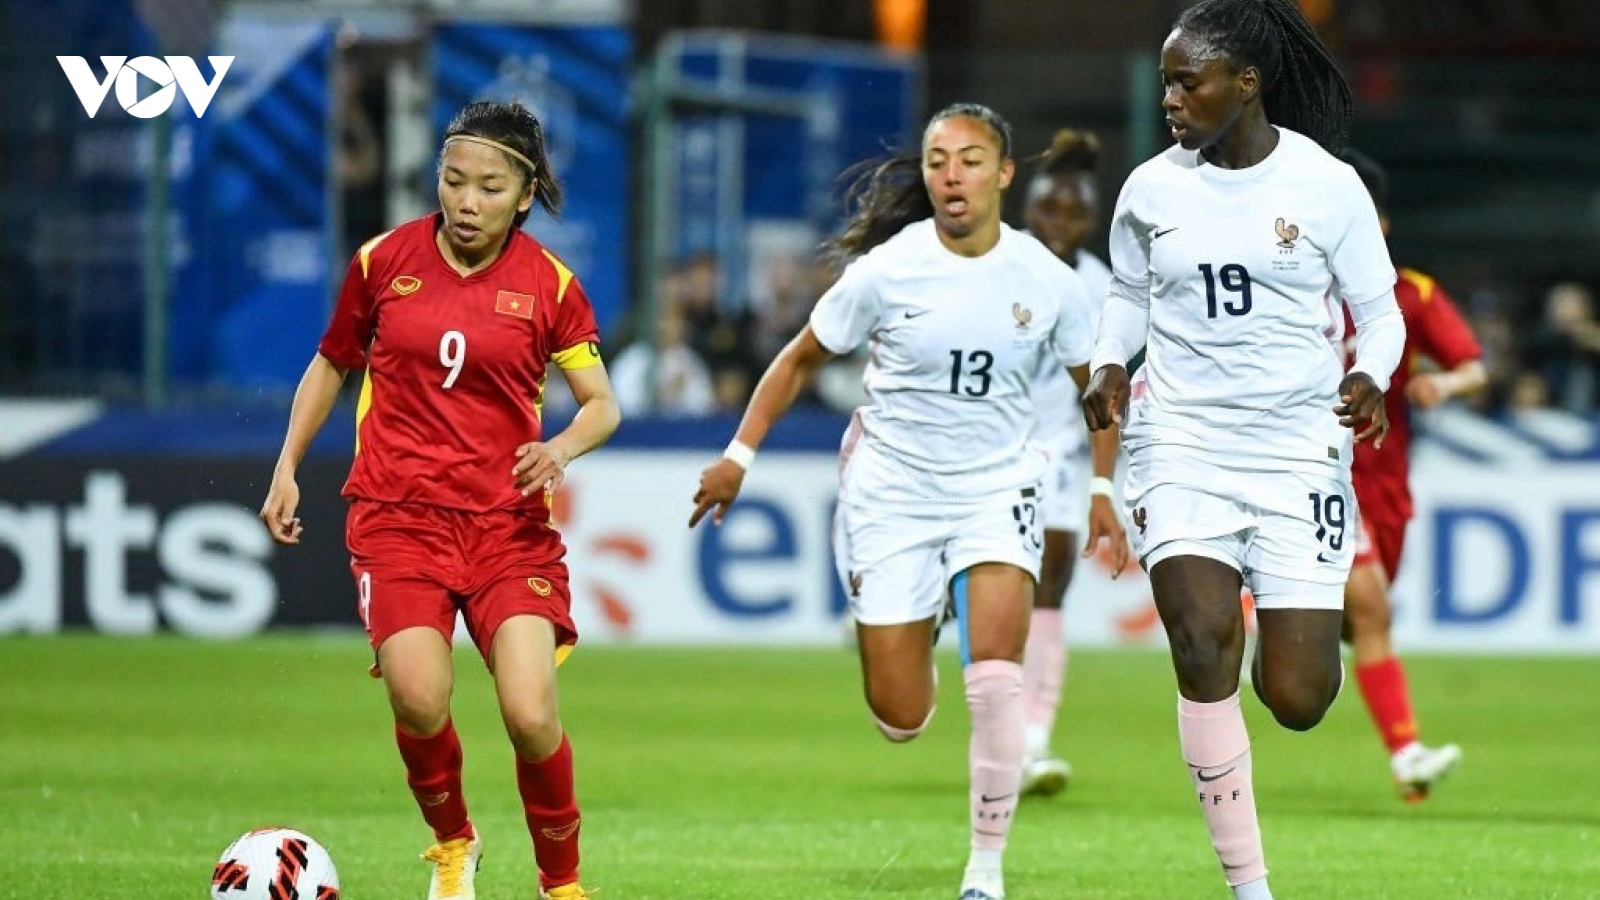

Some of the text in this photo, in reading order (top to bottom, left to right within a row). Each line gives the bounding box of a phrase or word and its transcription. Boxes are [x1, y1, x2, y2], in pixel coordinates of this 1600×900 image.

[1198, 263, 1252, 318] 19
[439, 330, 466, 389] 9
[949, 349, 994, 397] 13
[1309, 493, 1345, 550] 19
